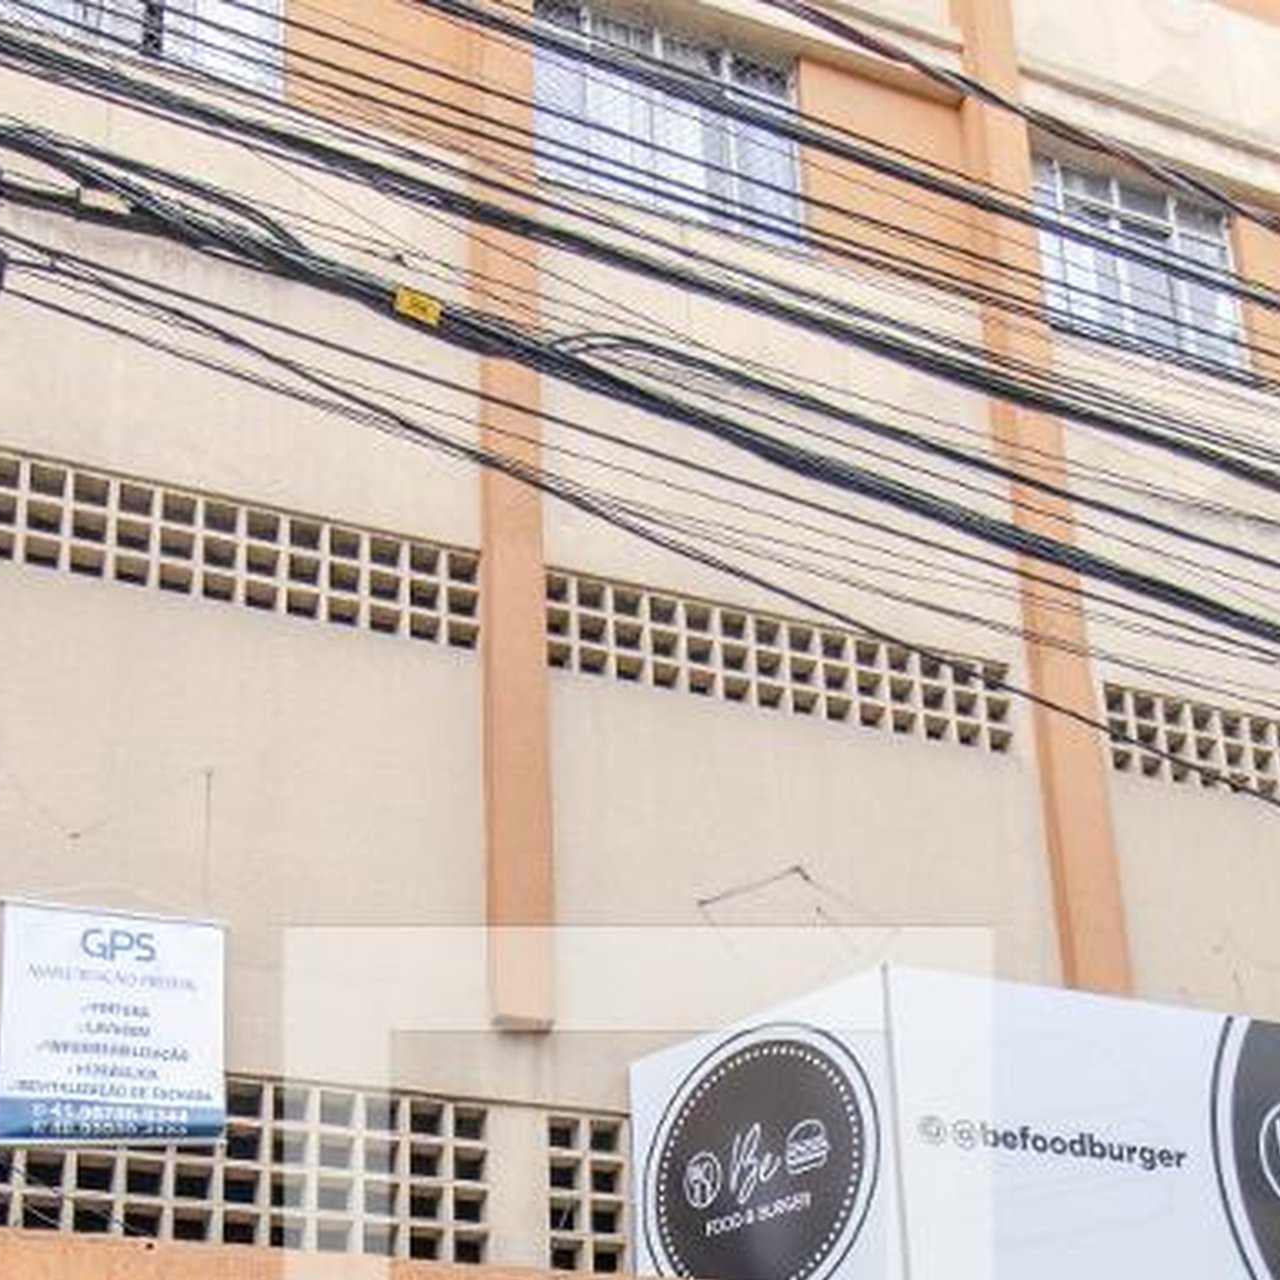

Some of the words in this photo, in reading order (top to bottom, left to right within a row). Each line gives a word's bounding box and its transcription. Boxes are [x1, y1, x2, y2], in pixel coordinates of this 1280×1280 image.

[81, 928, 156, 962] GPS
[730, 1122, 781, 1204] Be
[705, 1212, 742, 1236] FOOD
[757, 1191, 811, 1220] BURGER
